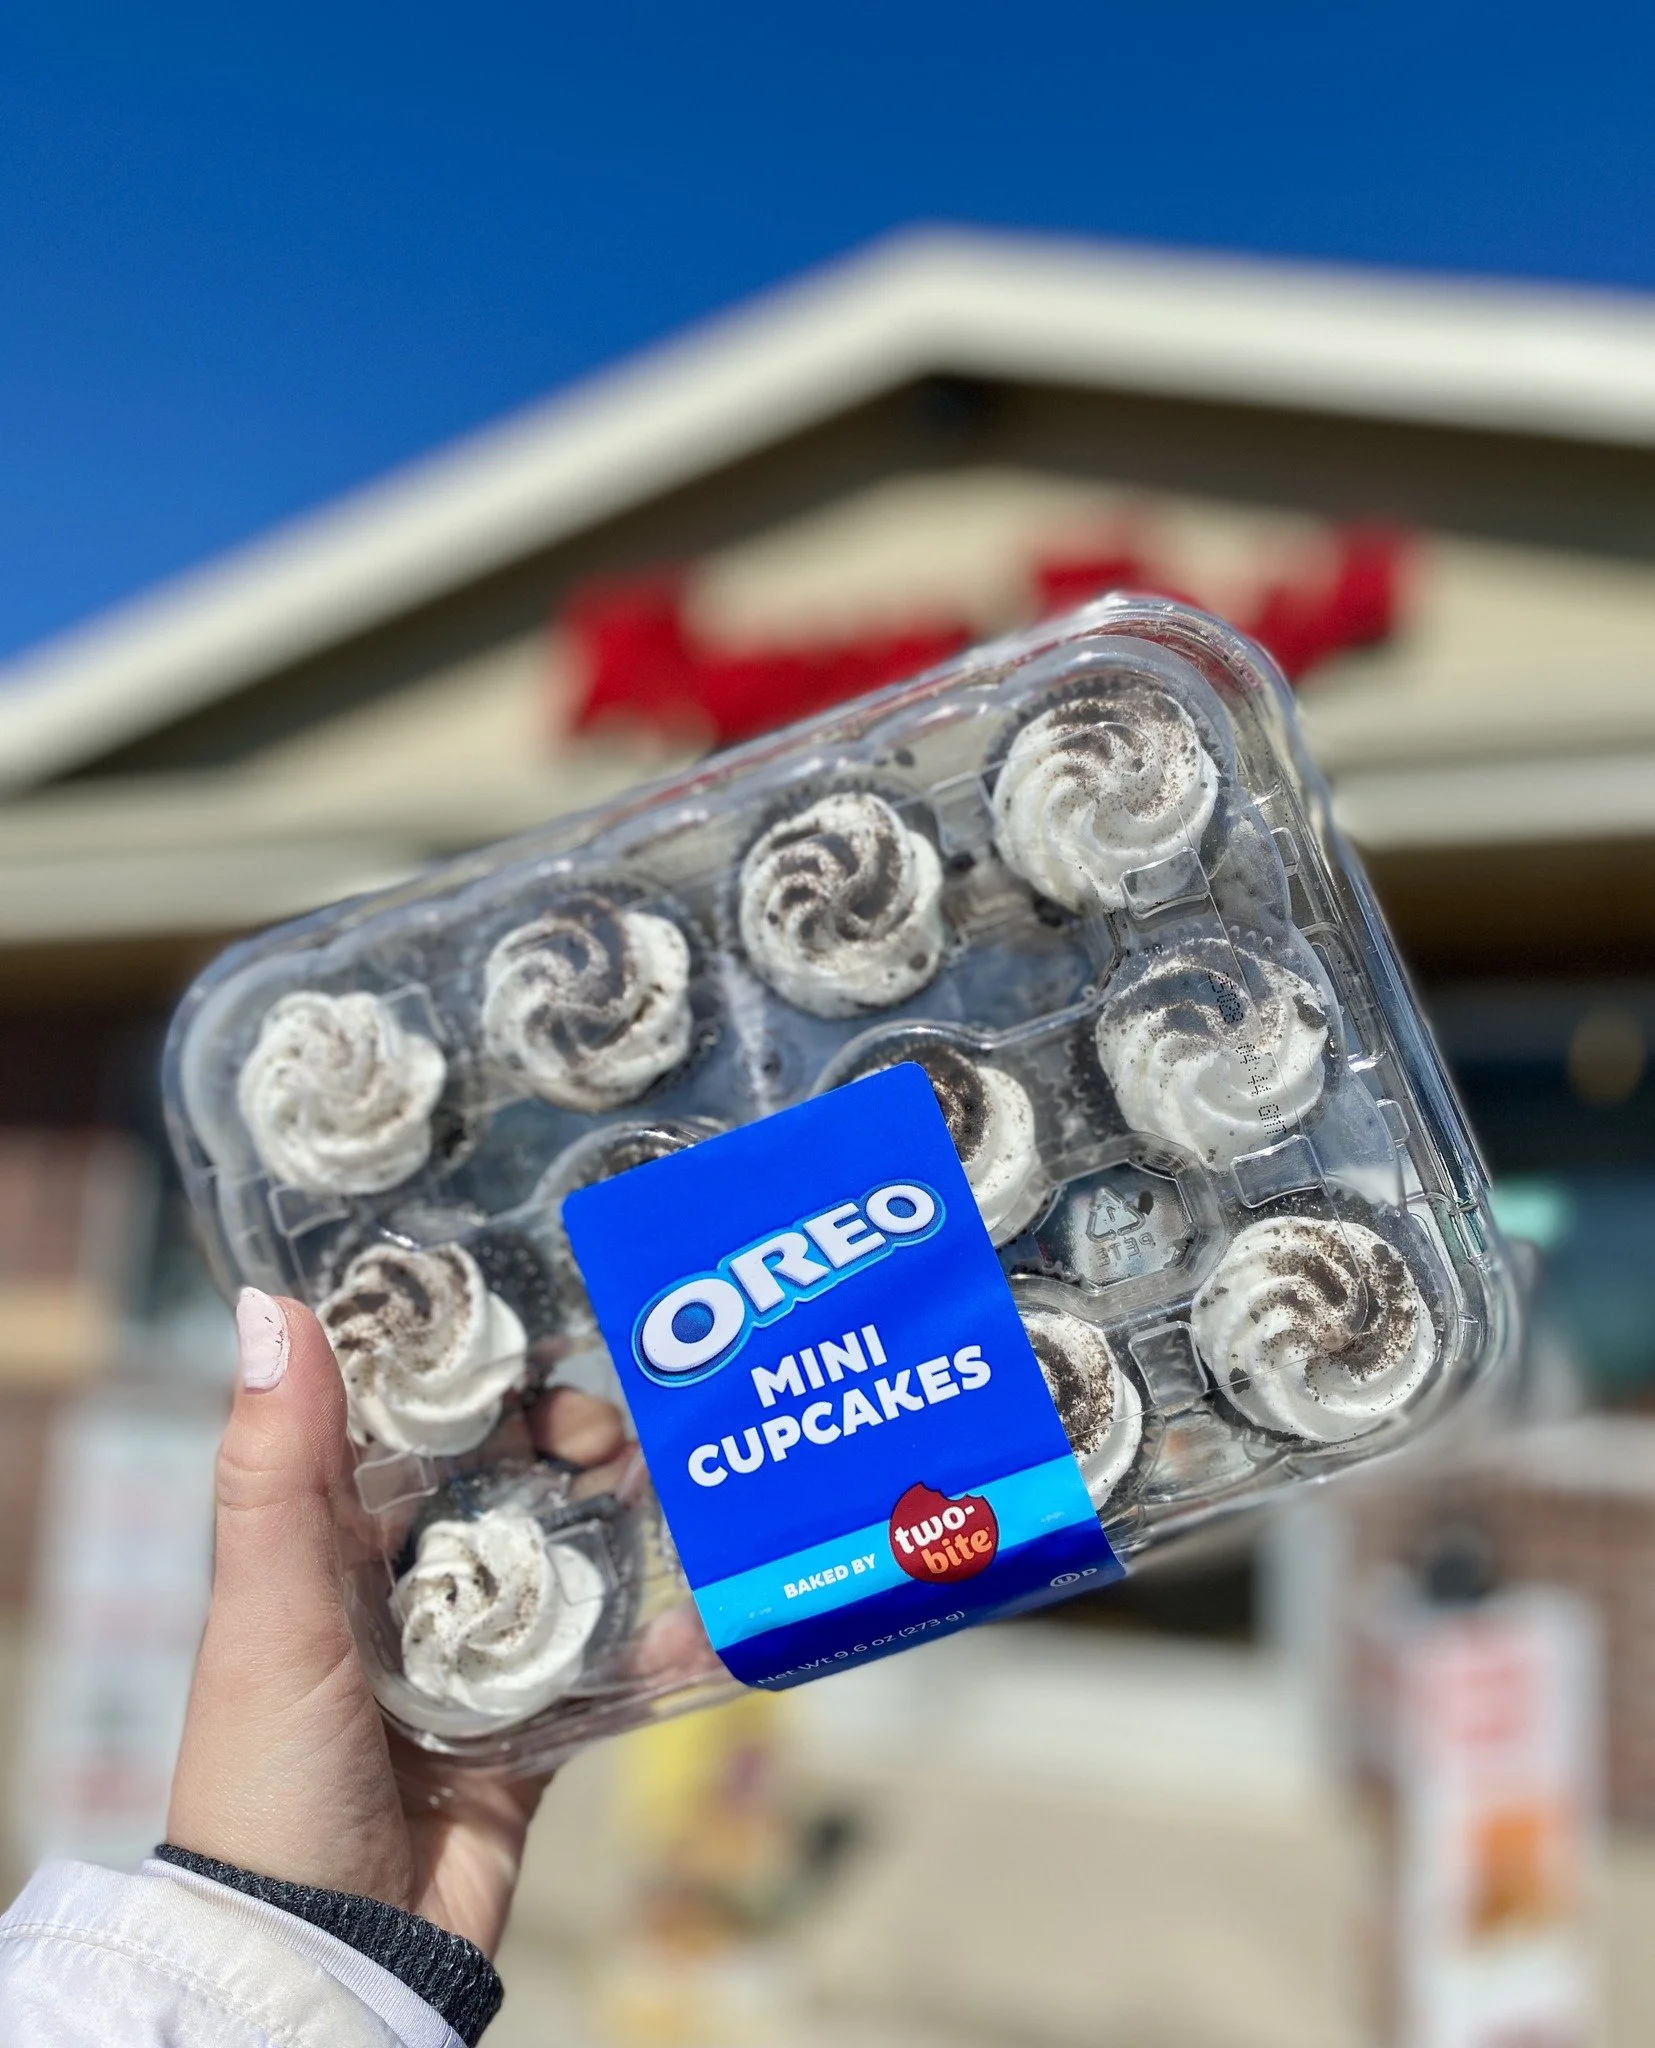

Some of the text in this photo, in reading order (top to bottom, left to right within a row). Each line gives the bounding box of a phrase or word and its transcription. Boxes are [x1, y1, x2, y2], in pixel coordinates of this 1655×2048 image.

[1236, 1044, 1271, 1095] 04:44
[1258, 1104, 1287, 1134] GMT
[641, 1184, 936, 1374] OREO
[750, 1323, 888, 1409] MINI
[687, 1344, 993, 1488] CUPCAKES
[894, 1505, 976, 1554] two-
[920, 1529, 993, 1574] bite
[783, 1553, 877, 1600] BAKED BY
[757, 1610, 966, 1685] Net Wt 9.6 oz (273 g)
